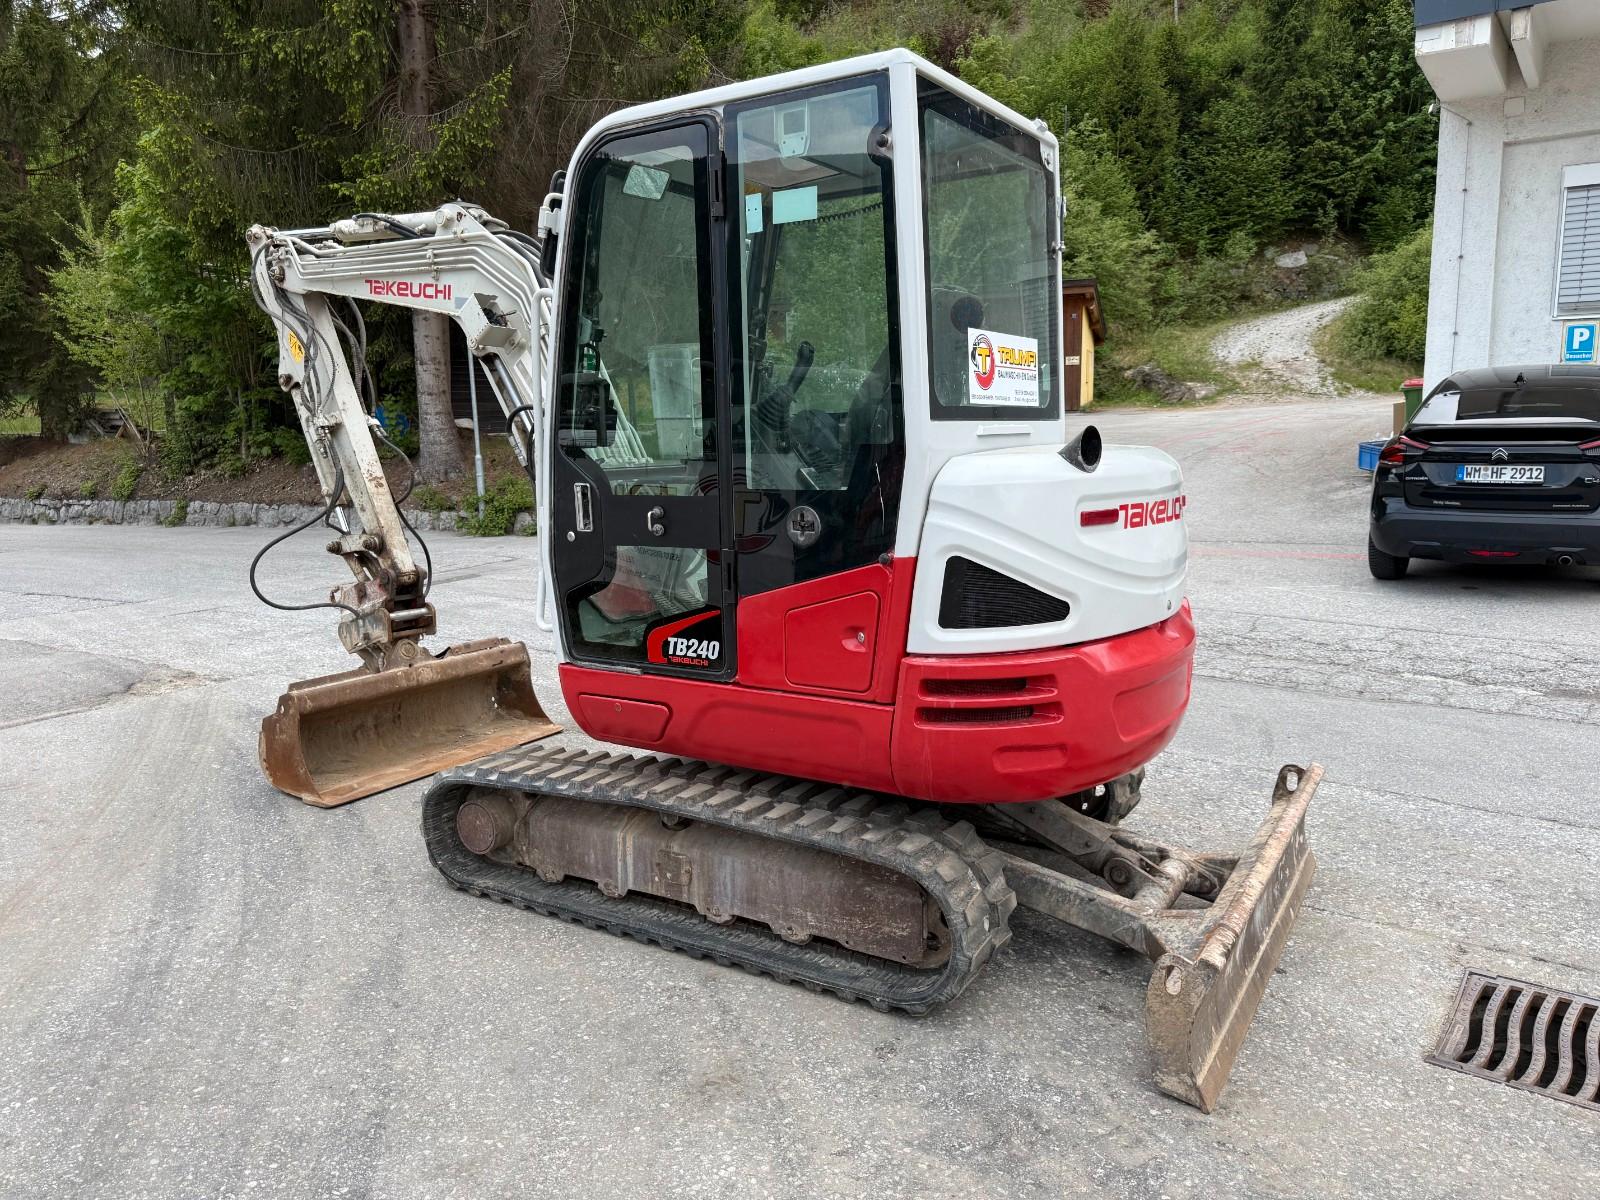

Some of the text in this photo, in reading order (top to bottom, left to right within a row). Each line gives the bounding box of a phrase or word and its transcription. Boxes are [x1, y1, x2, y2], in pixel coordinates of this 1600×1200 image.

[1572, 327, 1590, 350] P
[1465, 466, 1543, 480] WM HF 2912
[667, 637, 720, 660] TB240
